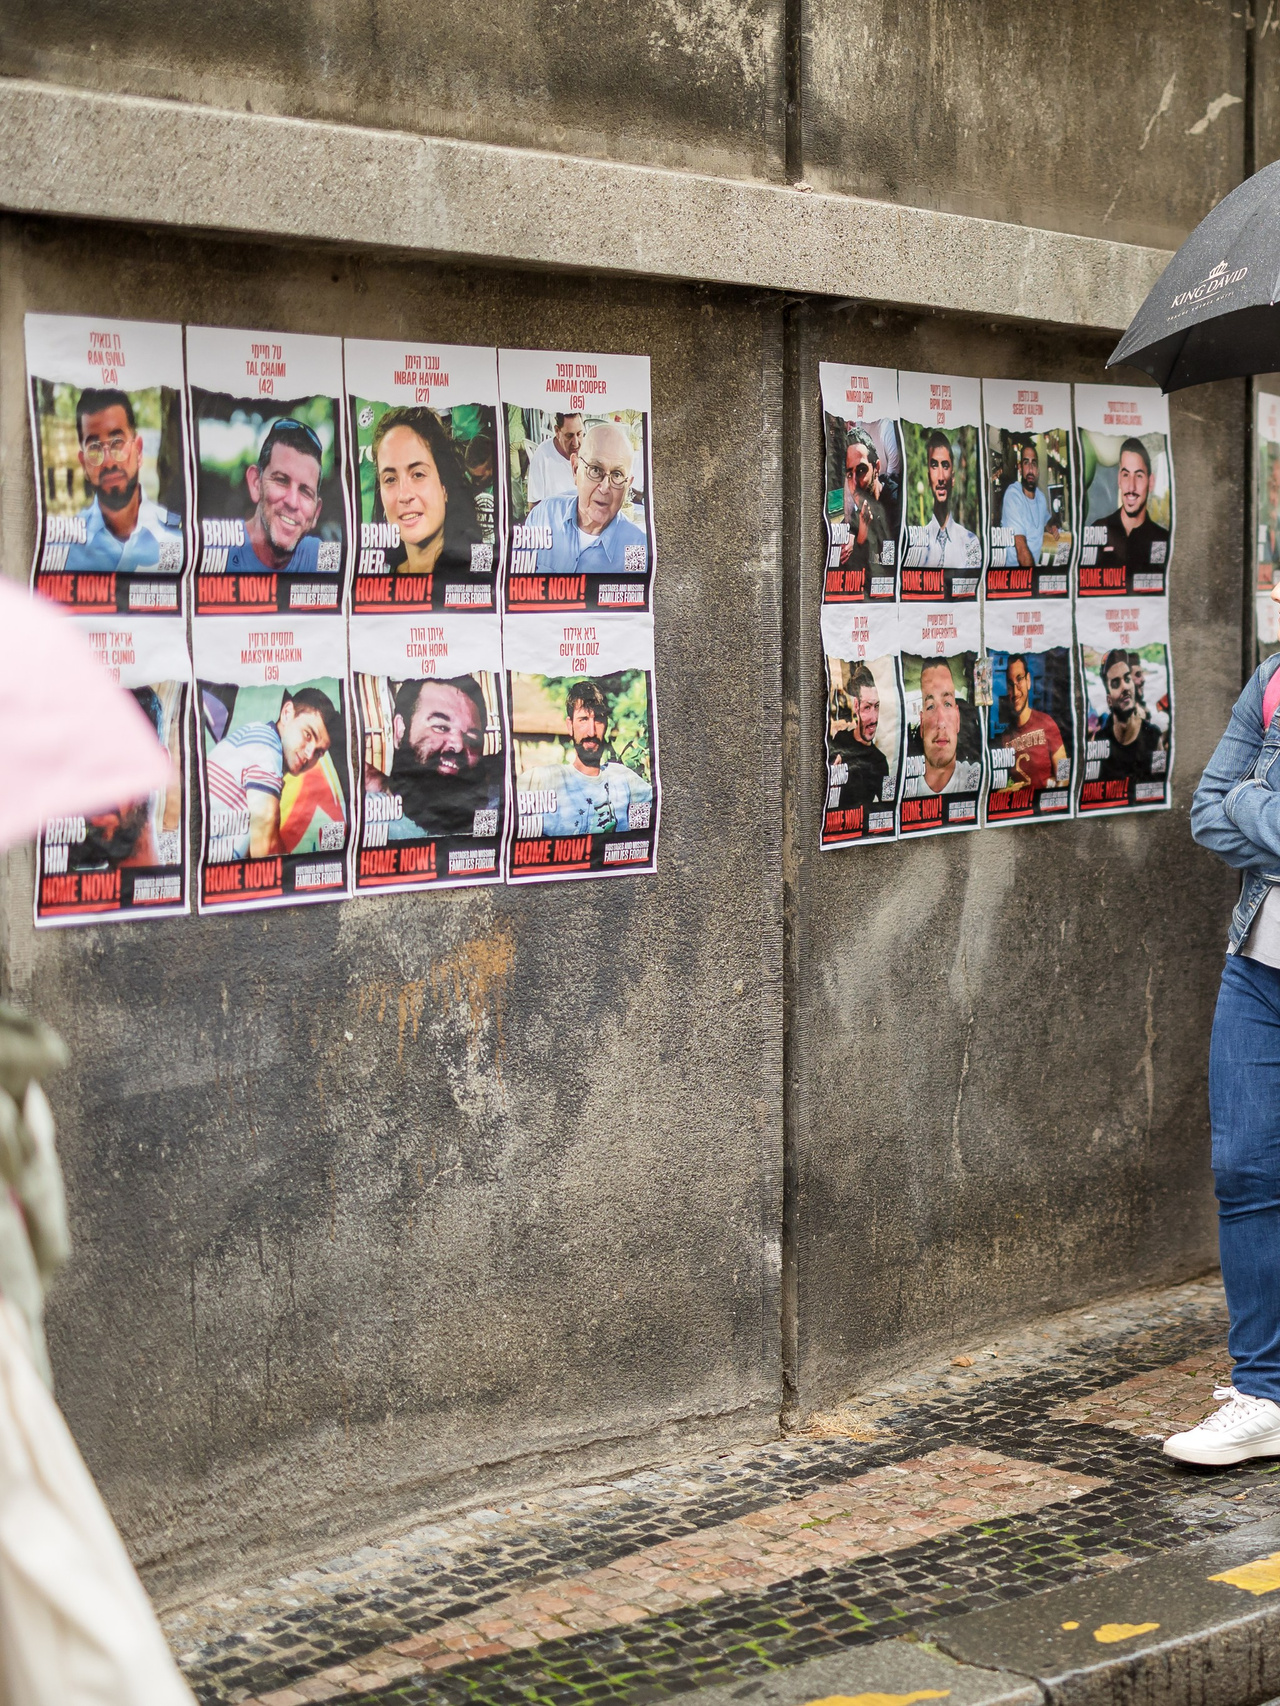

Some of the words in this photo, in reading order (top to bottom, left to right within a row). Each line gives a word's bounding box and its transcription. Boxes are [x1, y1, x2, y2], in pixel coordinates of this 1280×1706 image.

[1170, 285, 1206, 308] KING
[1206, 267, 1248, 294] DAVID
[87, 350, 104, 366] RAN
[269, 344, 282, 360] טל
[404, 355, 422, 370] הימן
[246, 360, 258, 376] TAL
[260, 361, 286, 378] CHAIMI
[423, 356, 440, 370] ענבר
[556, 363, 574, 379] קופר
[574, 364, 598, 378] עמירם
[101, 368, 118, 386] (24)
[258, 378, 274, 395] (42)
[394, 370, 417, 386] INBAR
[418, 372, 450, 387] HAYMAN
[546, 378, 578, 393] AMIRAM
[579, 380, 607, 394] COOPER
[415, 388, 430, 404] (27)
[570, 394, 586, 410] (85)
[46, 517, 87, 544] BRING
[202, 519, 245, 546] BRING
[361, 523, 400, 548] BRING
[513, 526, 552, 549] BRING
[991, 527, 1015, 547] BRING
[1083, 526, 1108, 546] BRING
[40, 544, 70, 571] HIM
[200, 548, 228, 572] HIM
[358, 550, 385, 574] HER
[511, 551, 537, 573] HIM
[38, 574, 74, 602] HOME
[77, 572, 116, 602] NOW!
[509, 578, 545, 600] HOME
[548, 574, 586, 600] NOW!
[845, 568, 865, 592] NOW!
[902, 571, 922, 592] HOME
[924, 569, 944, 592] NOW!
[988, 570, 1010, 590] HOME
[1010, 568, 1033, 589] NOW!
[1080, 568, 1102, 588] HOME
[1103, 565, 1126, 588] NOW!
[198, 576, 236, 602] HOME
[239, 574, 277, 602] NOW!
[356, 578, 393, 602] HOME
[395, 574, 433, 601] NOW!
[445, 592, 470, 604] FAMILIES
[471, 592, 491, 604] FORUM
[599, 592, 623, 602] FAMILIES
[624, 592, 644, 602] FORUM
[270, 631, 294, 647] מקסים
[410, 627, 426, 644] הורן
[427, 627, 444, 643] איתן
[112, 650, 136, 664] CUNIO
[240, 650, 273, 665] MAKSYM
[274, 648, 302, 663] HARKIN
[406, 642, 428, 658] EITAN
[428, 642, 448, 657] HORN
[559, 643, 576, 658] GUY
[576, 642, 600, 656] ILLOUZ
[264, 664, 280, 682] (35)
[421, 658, 436, 675] (37)
[571, 657, 587, 674] (26)
[991, 748, 1015, 769] BRING
[1086, 740, 1110, 761] BRING
[365, 795, 403, 821] BRING
[519, 790, 557, 814] BRING
[902, 800, 922, 822] HOME
[922, 795, 942, 820] NOW!
[45, 817, 86, 844] BRING
[211, 811, 250, 836] BRING
[517, 815, 543, 838] HIM
[363, 822, 389, 848] HIM
[44, 845, 68, 874] HIM
[208, 838, 234, 863] HIM
[361, 850, 398, 875] HOME
[400, 842, 436, 872] NOW!
[514, 841, 552, 865] HOME
[554, 835, 592, 862] NOW!
[604, 849, 629, 862] FAMILIES
[630, 848, 648, 860] FORUM
[206, 865, 242, 892] HOME
[245, 857, 282, 888] NOW!
[42, 875, 78, 904] HOME
[82, 870, 120, 900] NOW!
